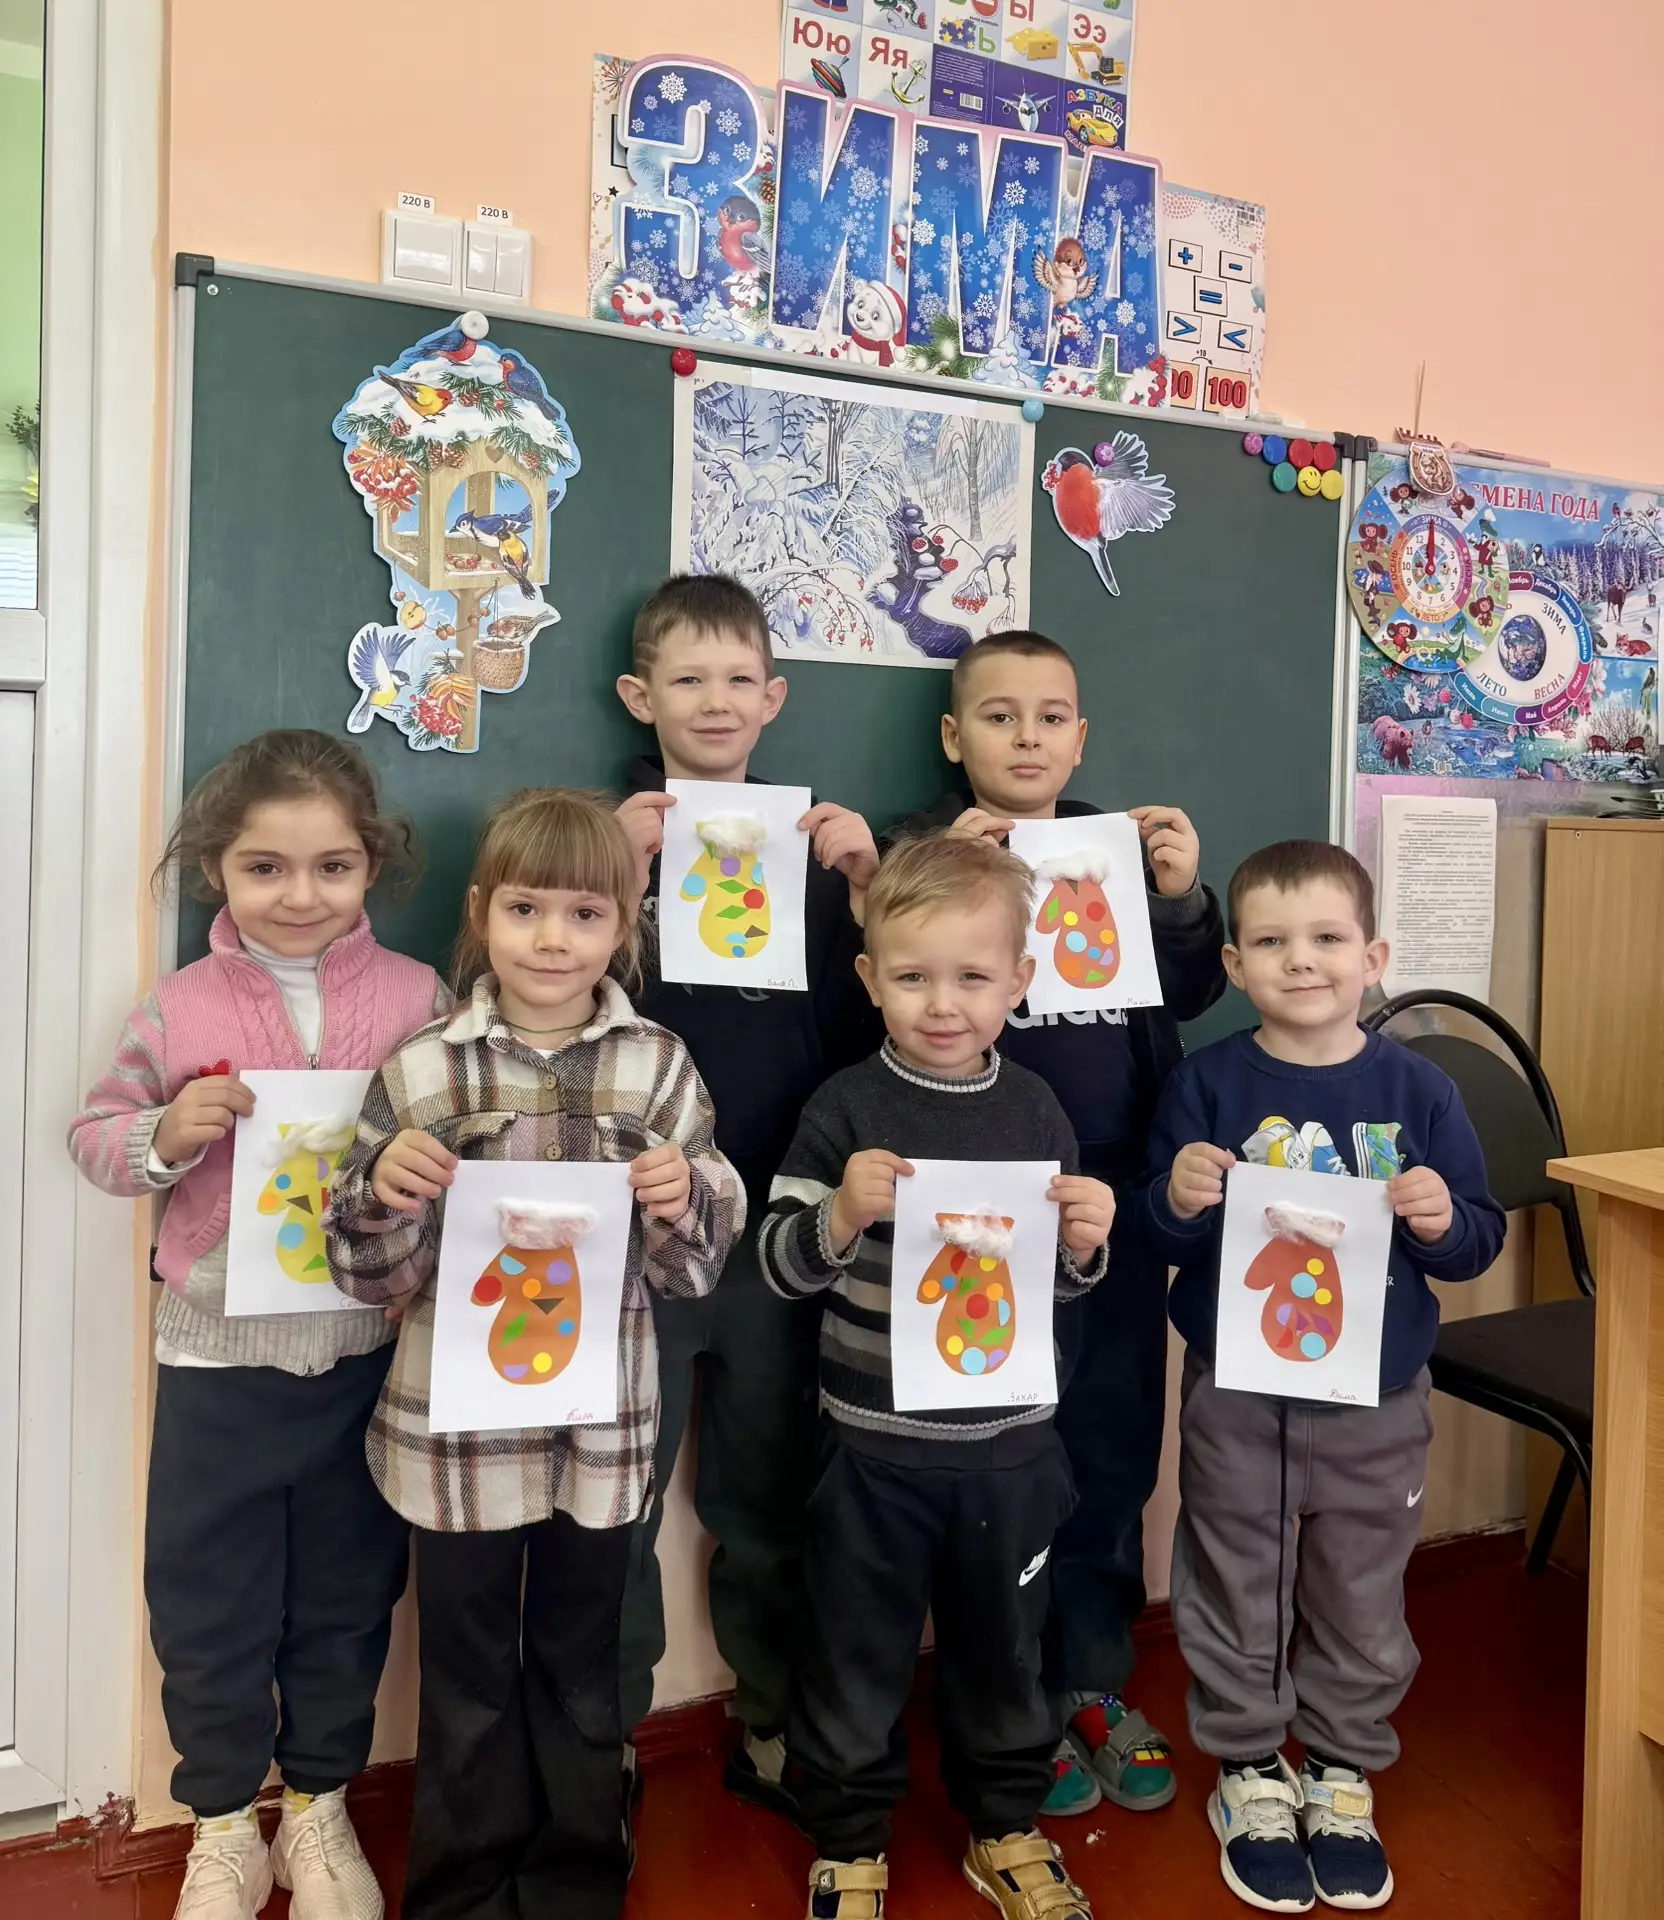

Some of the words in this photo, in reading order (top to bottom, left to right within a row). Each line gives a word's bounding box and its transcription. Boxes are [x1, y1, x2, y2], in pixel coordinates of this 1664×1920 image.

[793, 16, 851, 55] Юю
[1073, 14, 1107, 44] Ээ
[868, 36, 908, 69] Яя
[1067, 88, 1124, 116] АЗБУКА
[1094, 105, 1123, 128] ДЛЯ
[402, 195, 422, 207] 220
[481, 206, 499, 218] 220
[617, 54, 1163, 380] ЗИМА
[1208, 376, 1247, 409] 100
[1472, 483, 1545, 513] МЕНА
[1550, 492, 1599, 521] ГОДА
[1406, 547, 1413, 555] 11
[1416, 535, 1424, 544] 12
[1390, 550, 1398, 580] ОСЕНЬ
[1402, 562, 1411, 571] 10
[1464, 560, 1472, 588] ВЕСНА
[1509, 576, 1530, 585] оябрь
[1535, 578, 1557, 595] Декабрь
[1421, 613, 1440, 622] ЛЕТО
[1541, 603, 1567, 635] ЗИМА
[1578, 625, 1588, 660] Февраль
[1476, 672, 1507, 697] ЛЕТО
[1534, 673, 1566, 700] ВЕСНА
[1571, 671, 1583, 689] Март
[1525, 711, 1538, 720] Май
